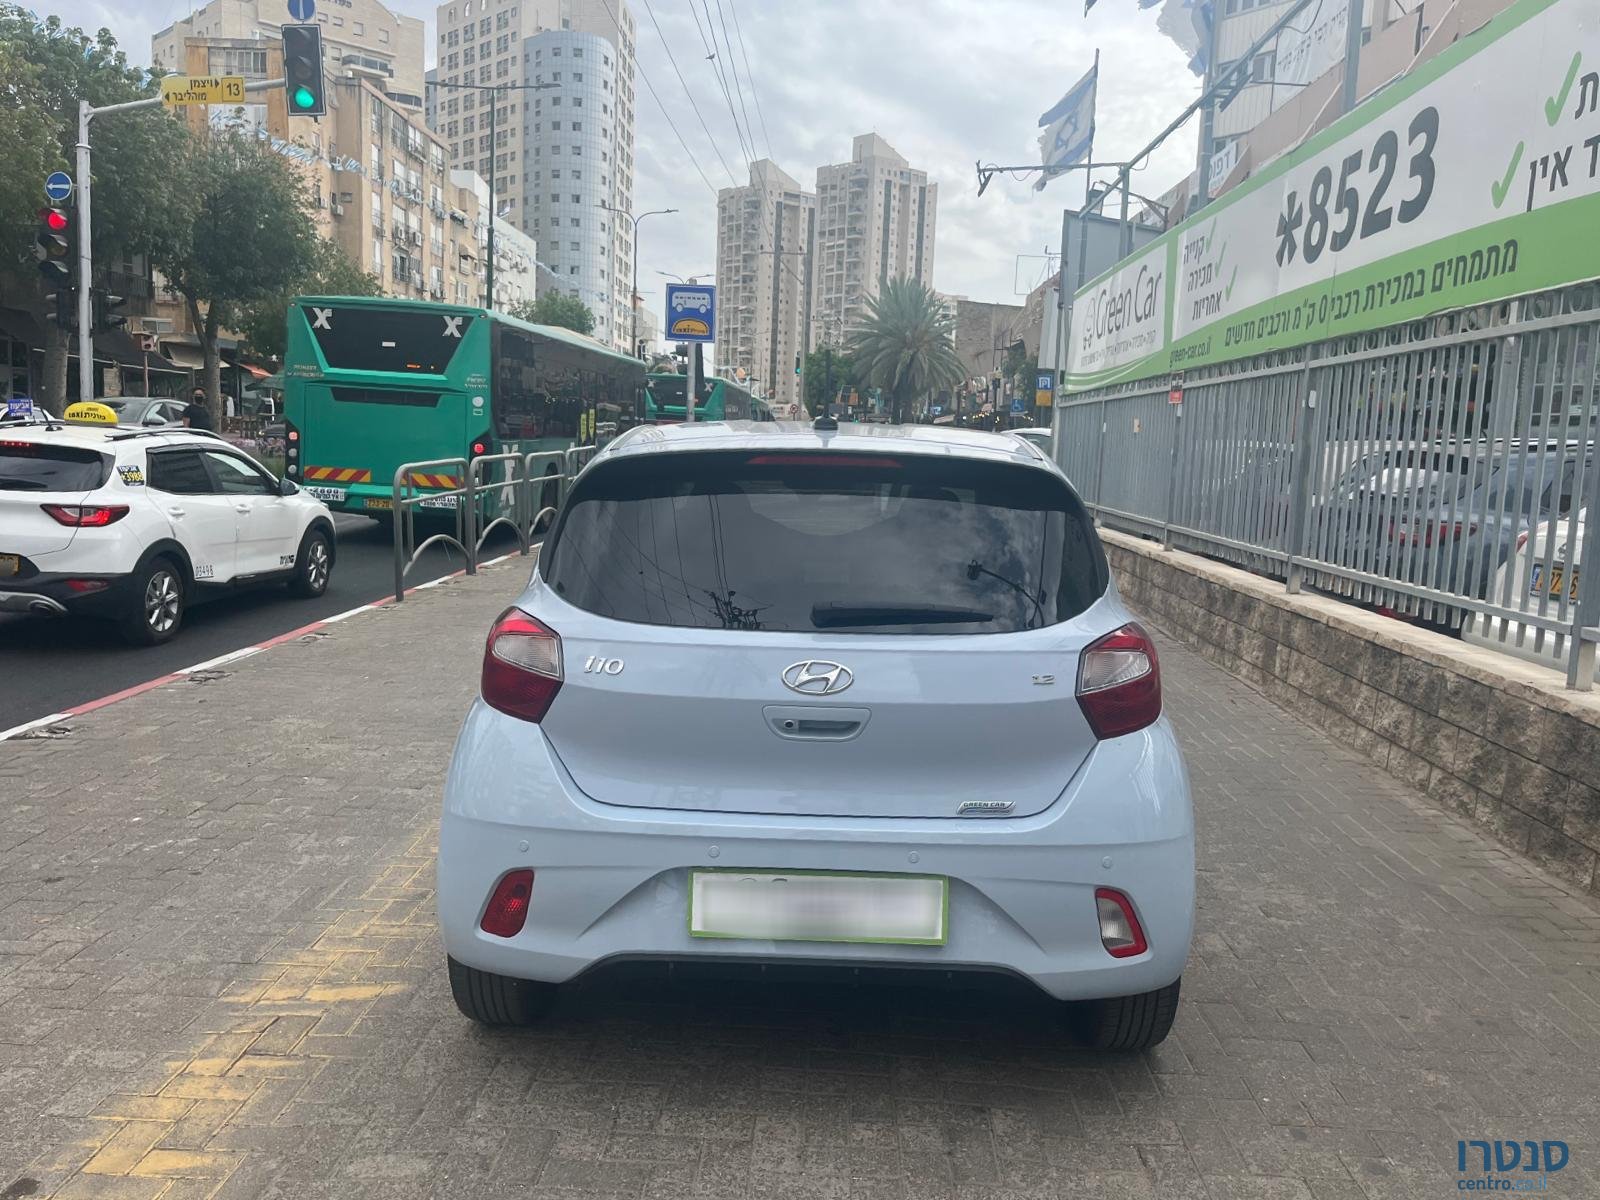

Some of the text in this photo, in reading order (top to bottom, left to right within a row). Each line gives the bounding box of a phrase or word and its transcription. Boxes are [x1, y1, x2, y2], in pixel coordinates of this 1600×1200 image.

[172, 89, 207, 101] מוהליבר
[190, 79, 213, 90] ויצמן
[226, 83, 240, 97] 13
[1526, 145, 1574, 213] אין
[1183, 235, 1205, 265] קנייה
[1187, 262, 1213, 293] מכירה
[1430, 238, 1519, 294] מתמחים
[1096, 264, 1162, 340] Green Car
[1192, 290, 1222, 321] אחריות
[1331, 289, 1360, 321] רכבי
[1362, 268, 1426, 312] במכירת
[1224, 320, 1256, 347] חדשים
[1256, 309, 1291, 339] ורכבים
